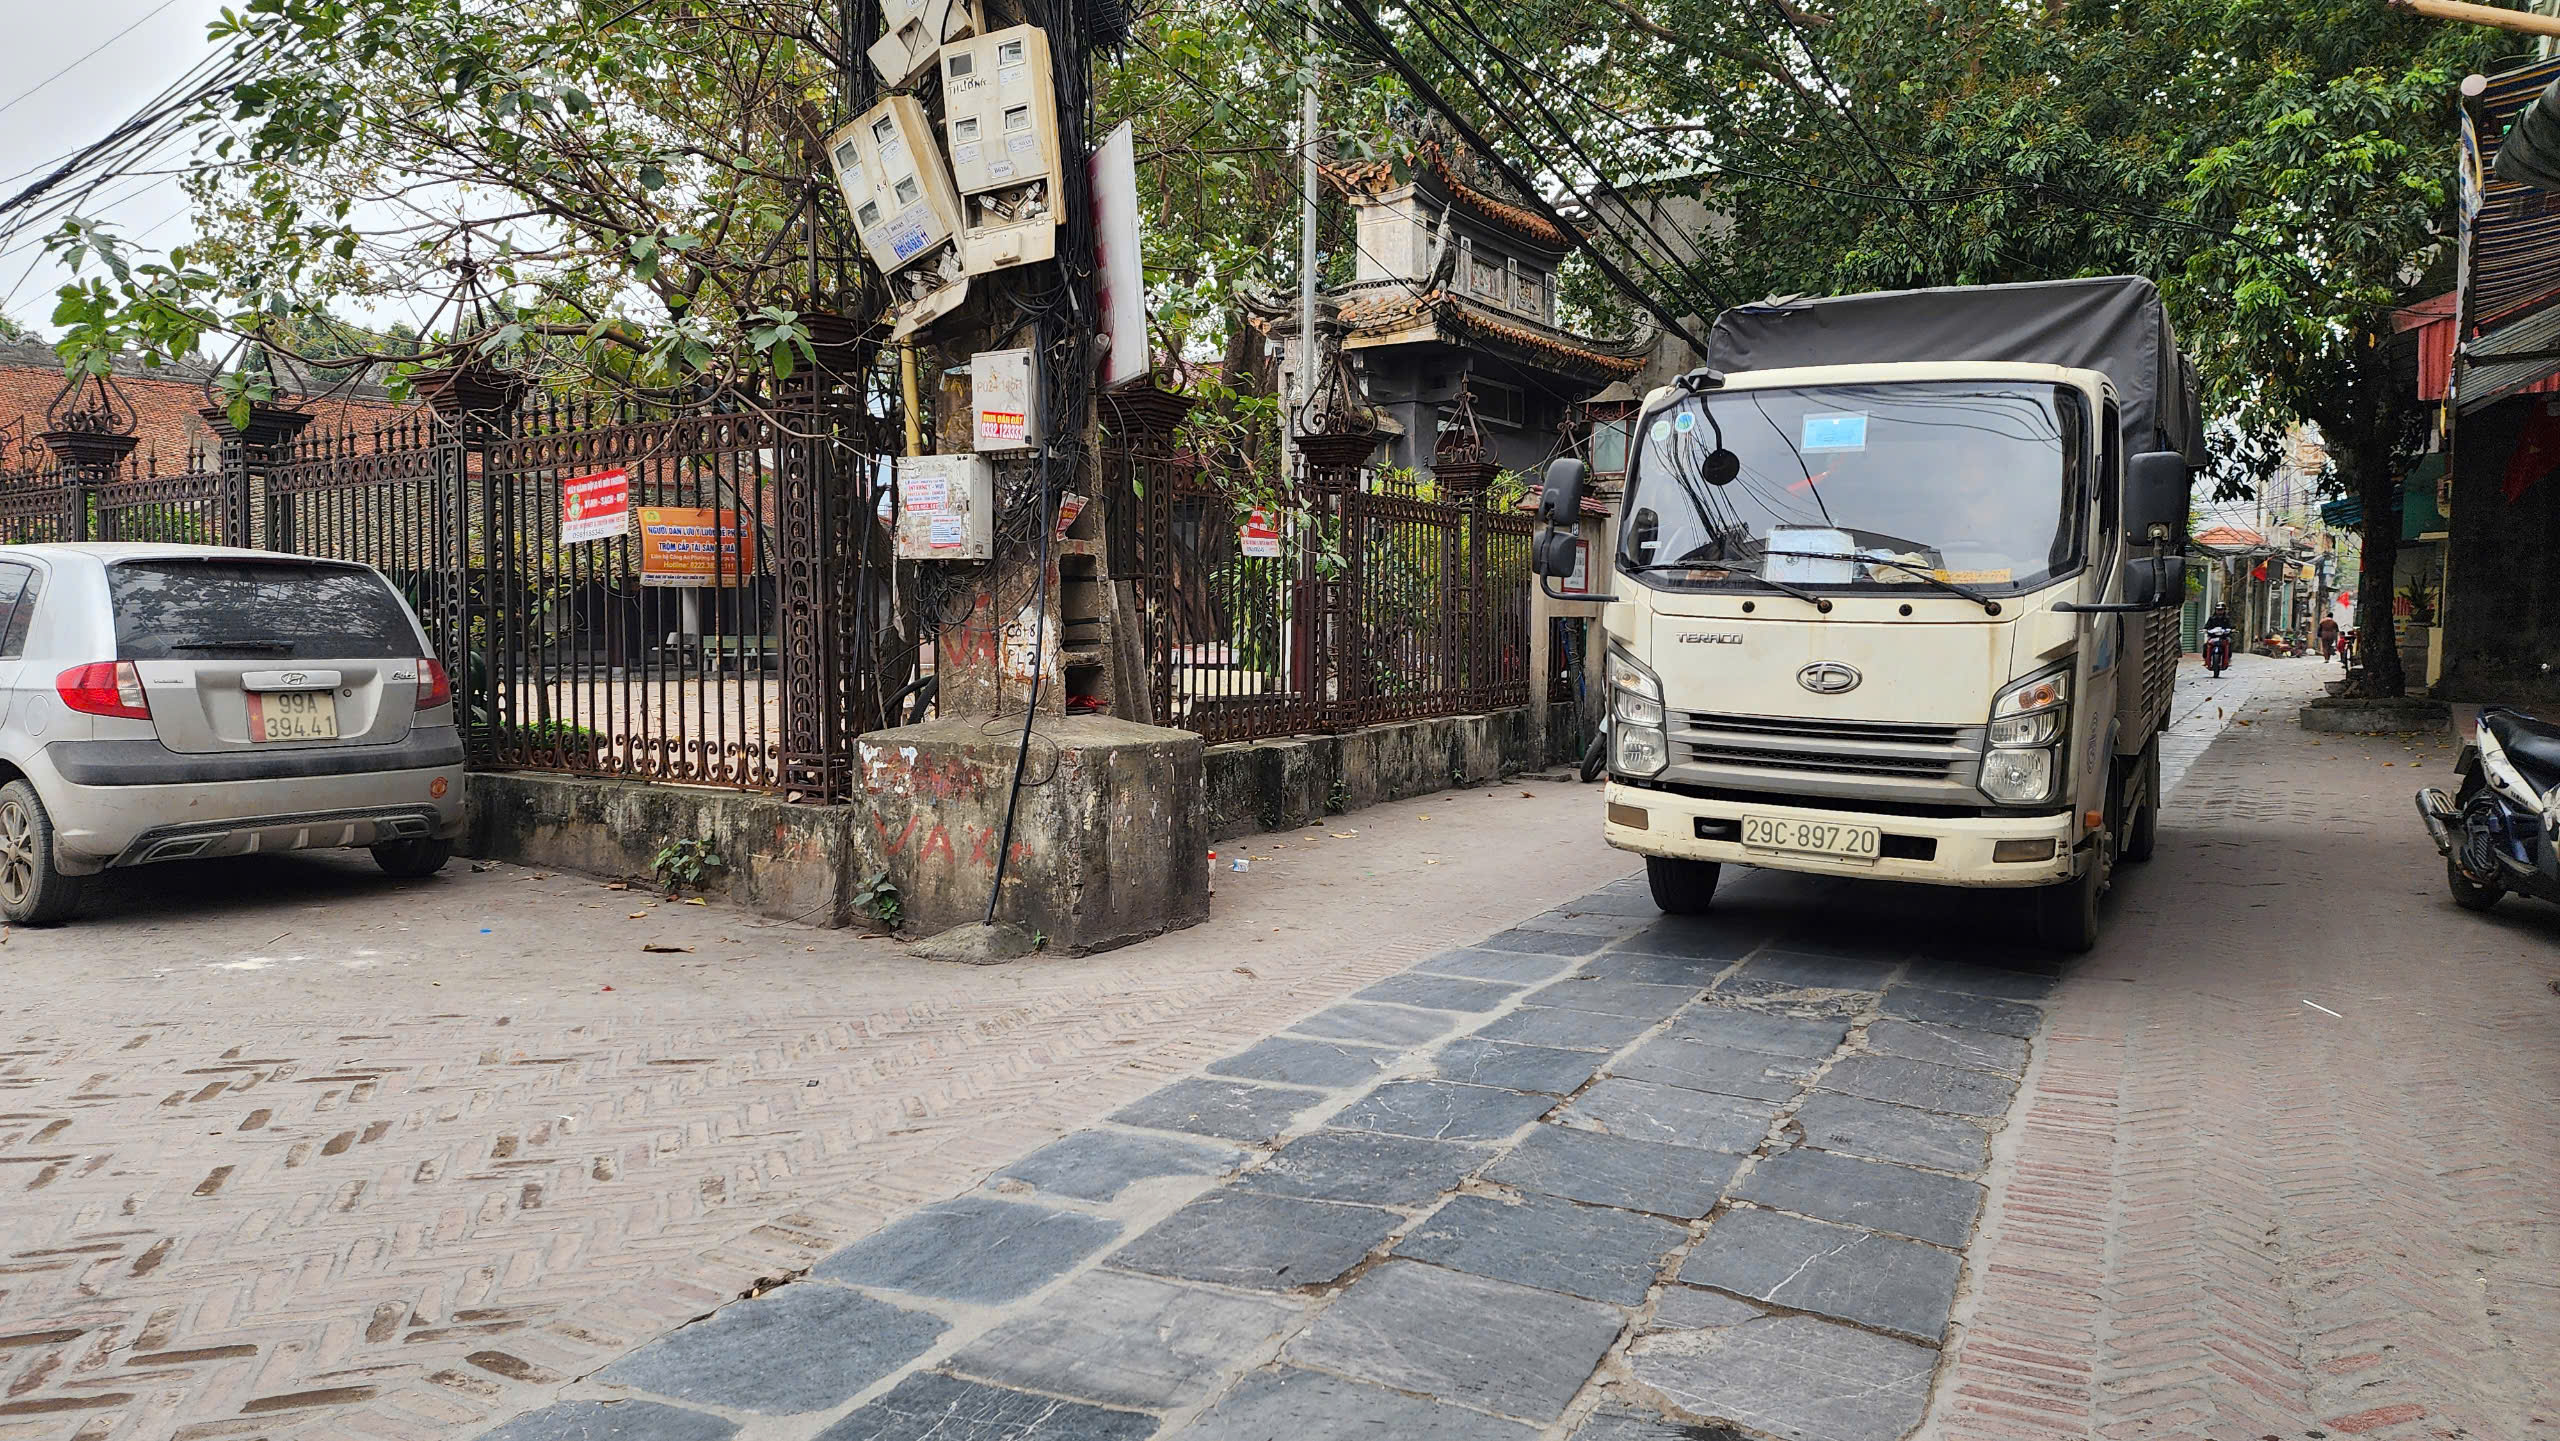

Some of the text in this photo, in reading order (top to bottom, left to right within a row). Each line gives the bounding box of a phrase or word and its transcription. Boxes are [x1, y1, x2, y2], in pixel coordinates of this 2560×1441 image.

[1675, 632, 1743, 645] TERACO
[278, 693, 318, 715] 99A
[265, 715, 335, 739] 394.41
[1746, 819, 1875, 854] 29C-897.20
